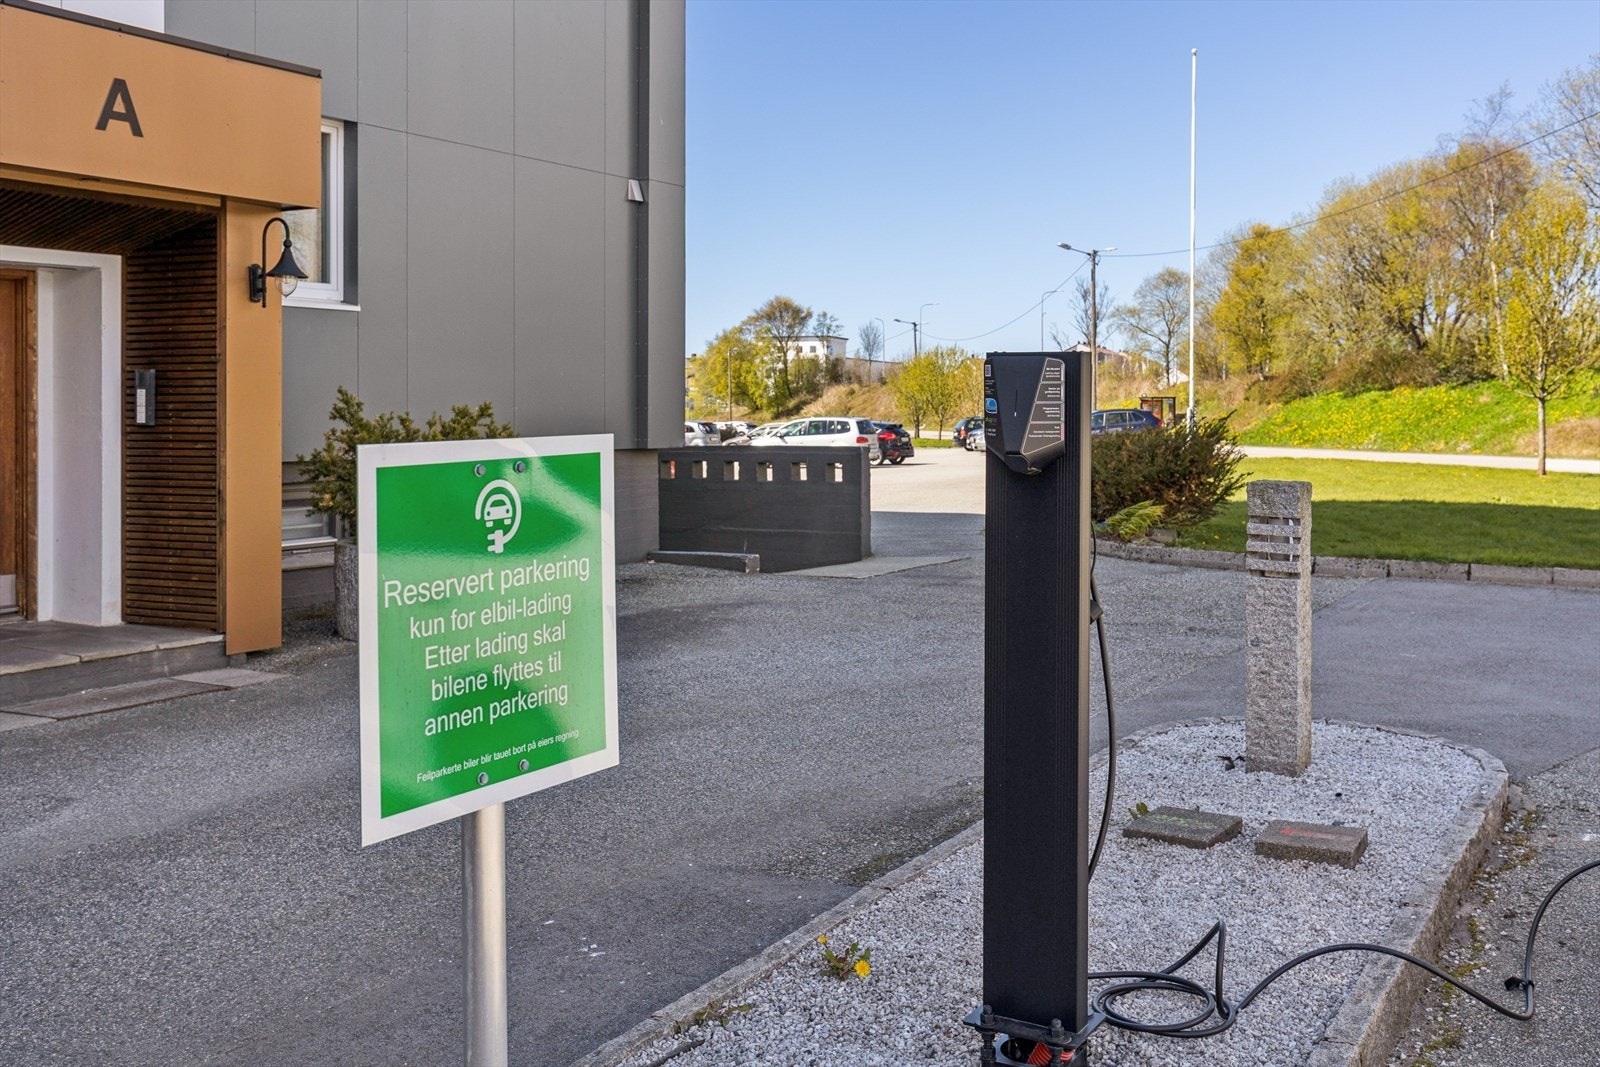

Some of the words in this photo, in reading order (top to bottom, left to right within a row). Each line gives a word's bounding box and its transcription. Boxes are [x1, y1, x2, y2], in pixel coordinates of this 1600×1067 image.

[95, 77, 144, 138] A
[384, 568, 494, 608] Reservert
[501, 555, 590, 595] parkering
[410, 617, 445, 639] kun
[451, 608, 476, 631] for
[481, 593, 571, 625] elbil-lading
[425, 644, 470, 670] Etter
[476, 632, 528, 658] lading
[533, 620, 566, 646] skal
[431, 672, 487, 701] bilene
[493, 660, 543, 689] flyttes
[548, 651, 562, 673] til
[425, 706, 483, 736] annen
[490, 684, 568, 725] parkering
[416, 763, 461, 783] Feilparkerte
[463, 757, 479, 770] biler
[480, 754, 492, 765] blir
[494, 748, 511, 761] tauet
[513, 743, 526, 755] bort
[527, 740, 536, 752] på
[538, 736, 554, 748] eiers
[555, 729, 579, 743] regning
